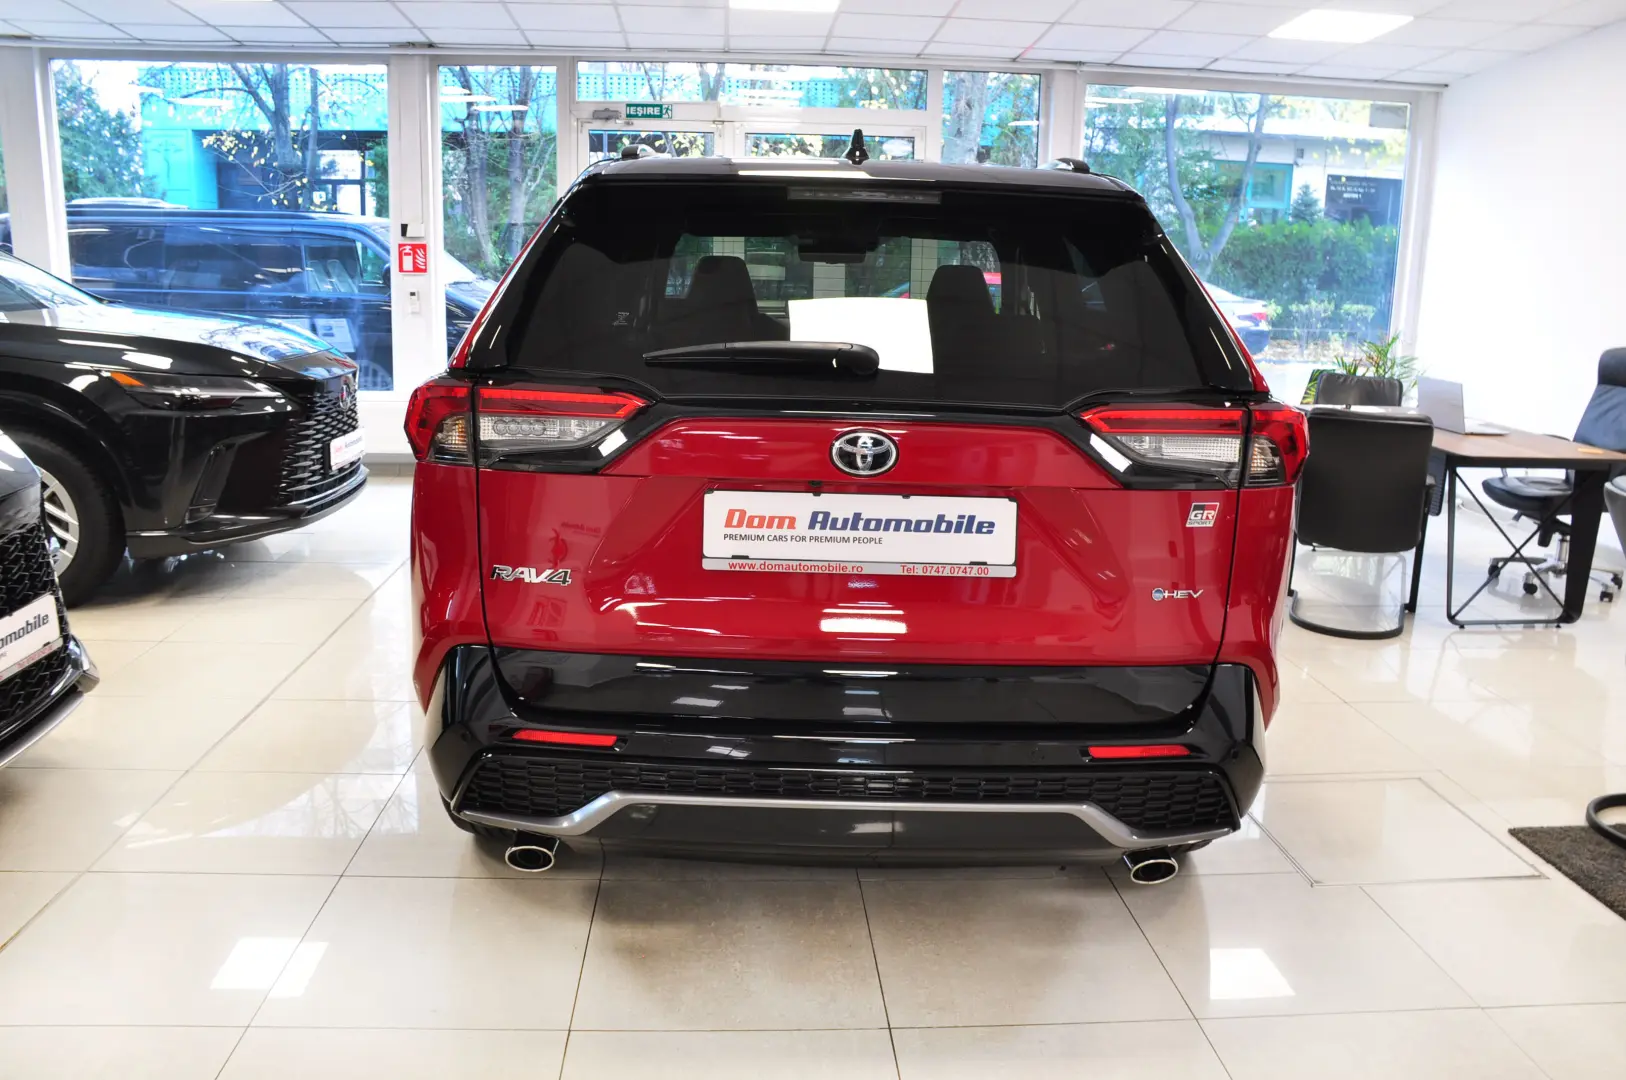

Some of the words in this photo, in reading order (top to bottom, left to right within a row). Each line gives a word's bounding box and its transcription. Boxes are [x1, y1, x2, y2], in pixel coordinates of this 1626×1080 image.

[1190, 510, 1216, 520] GR
[724, 509, 796, 530] Dom
[808, 511, 996, 534] Automobile
[723, 533, 765, 542] PREMIUM
[767, 534, 789, 542] CARS
[790, 535, 807, 543] FOR
[809, 536, 850, 544] PREMIUM
[853, 537, 883, 545] PEOPLE
[728, 561, 863, 573] www.domautomobile.ro
[901, 564, 919, 574] Tel:
[922, 566, 989, 575] 0747.0747.00
[490, 565, 571, 586] RAV4
